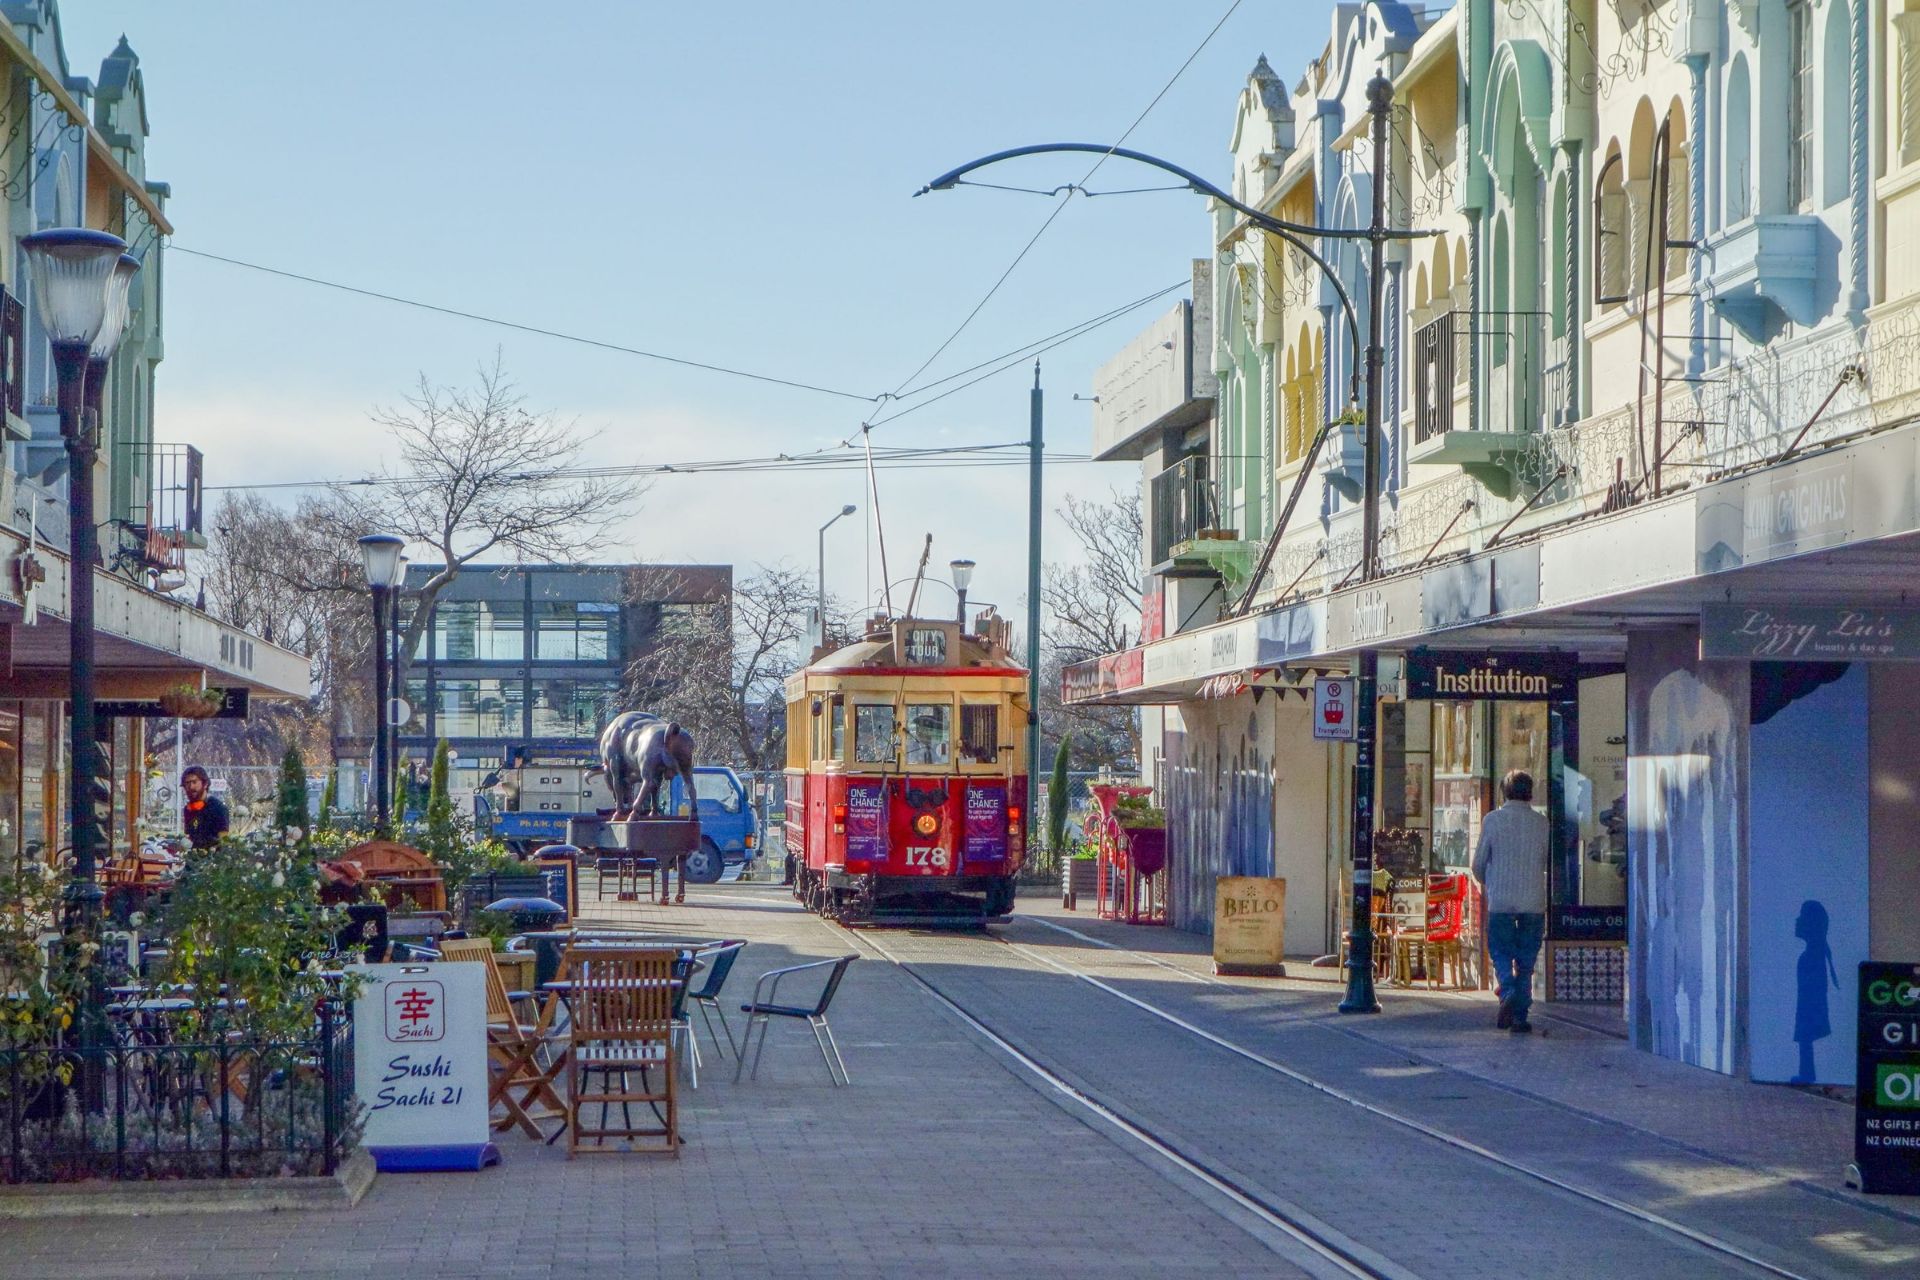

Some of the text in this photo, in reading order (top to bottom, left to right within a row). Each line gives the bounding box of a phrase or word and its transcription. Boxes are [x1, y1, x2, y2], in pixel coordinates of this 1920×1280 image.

[1747, 474, 1846, 539] KIWI ORIGINALS
[912, 630, 938, 642] CITY
[1732, 609, 1892, 656] Lizzy Lu's
[911, 645, 938, 657] TOUR
[1815, 642, 1894, 655] beauty & day spa
[1436, 666, 1548, 694] Institution
[850, 788, 867, 798] ONE
[850, 798, 883, 807] CHANCE
[968, 799, 999, 808] CHANCE
[905, 847, 946, 866] 178
[1222, 896, 1279, 918] BELO
[1562, 915, 1601, 927] Phone
[394, 987, 435, 1026] 幸
[395, 1024, 434, 1040] Sachi
[381, 1055, 453, 1083] Sushi
[370, 1086, 463, 1110] Sachi 21
[1866, 1119, 1880, 1129] NZ
[1883, 1119, 1912, 1130] GIFTS
[1866, 1135, 1880, 1145] NZ
